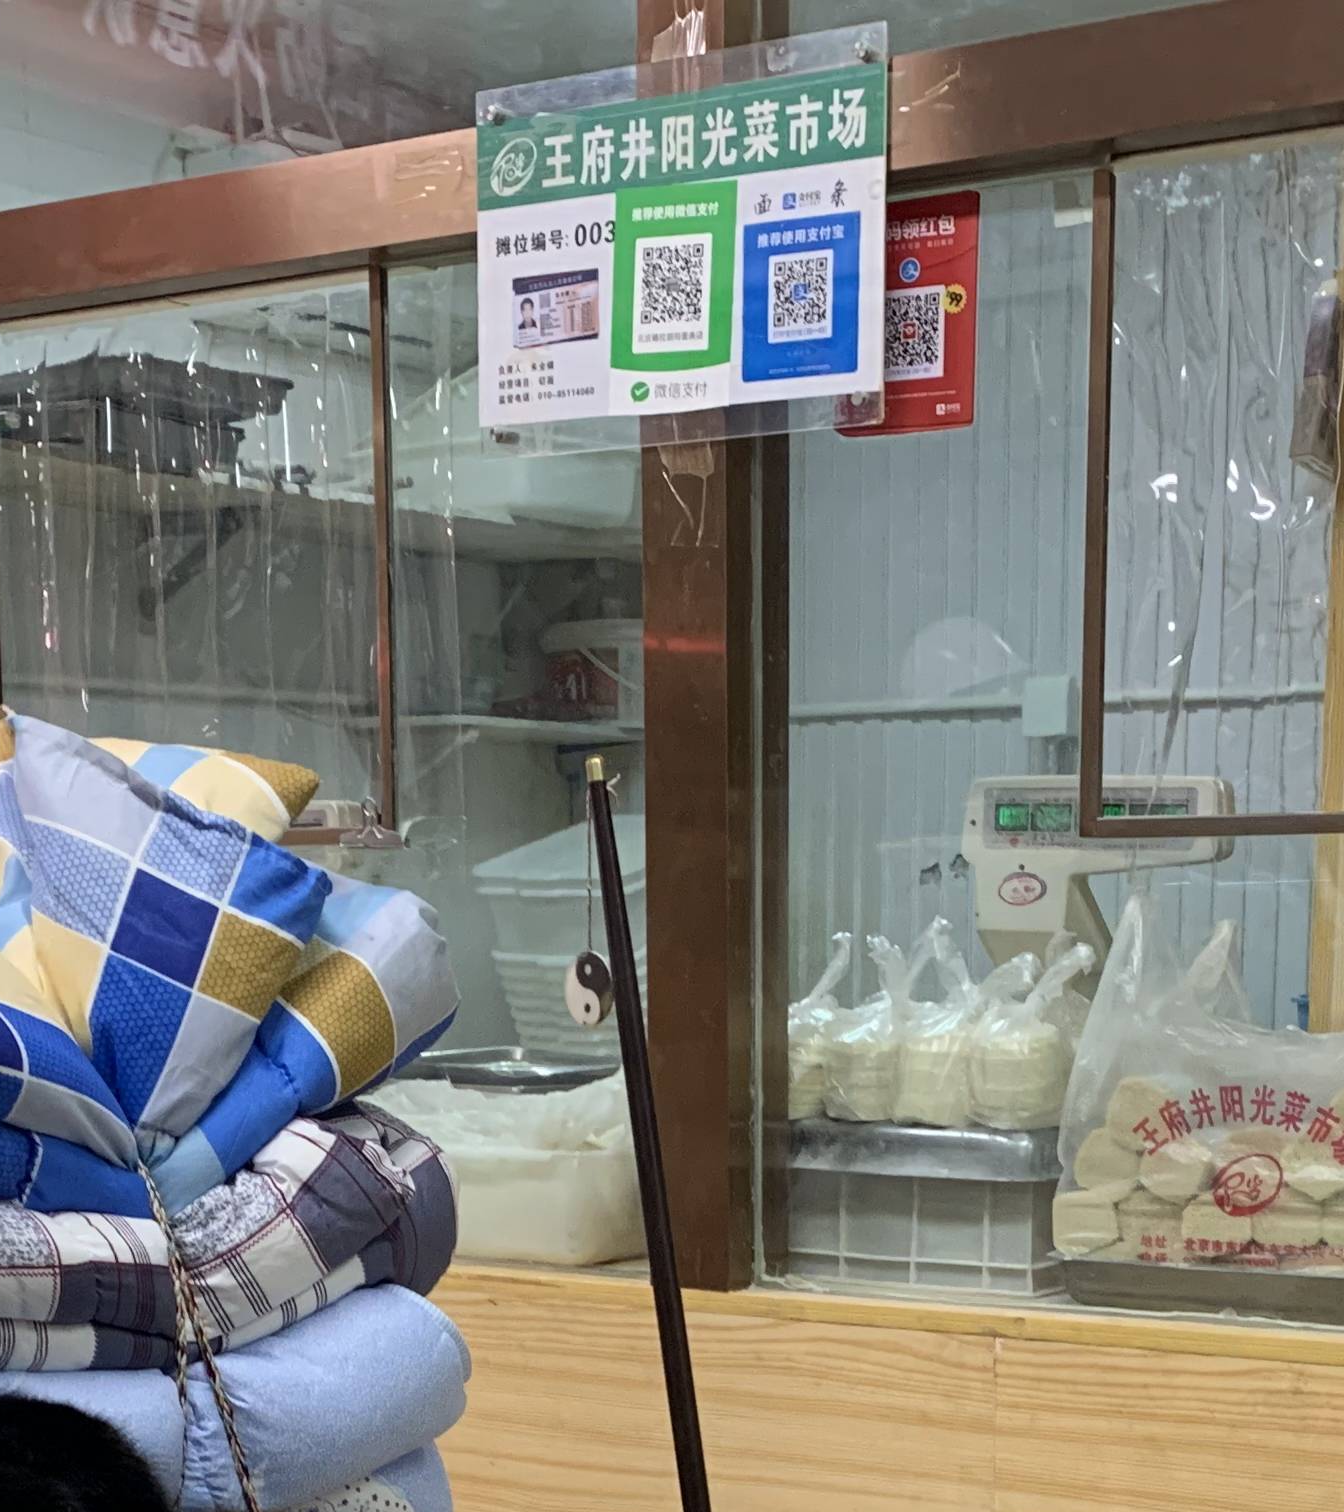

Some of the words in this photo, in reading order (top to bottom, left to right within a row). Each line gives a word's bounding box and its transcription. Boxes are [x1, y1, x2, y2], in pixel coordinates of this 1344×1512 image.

[541, 87, 867, 188] 王府井阳光菜市场
[632, 202, 720, 222] 推荐使用微信支付
[757, 224, 845, 249] 推荐使用支付宝
[654, 382, 708, 400] 微信支付
